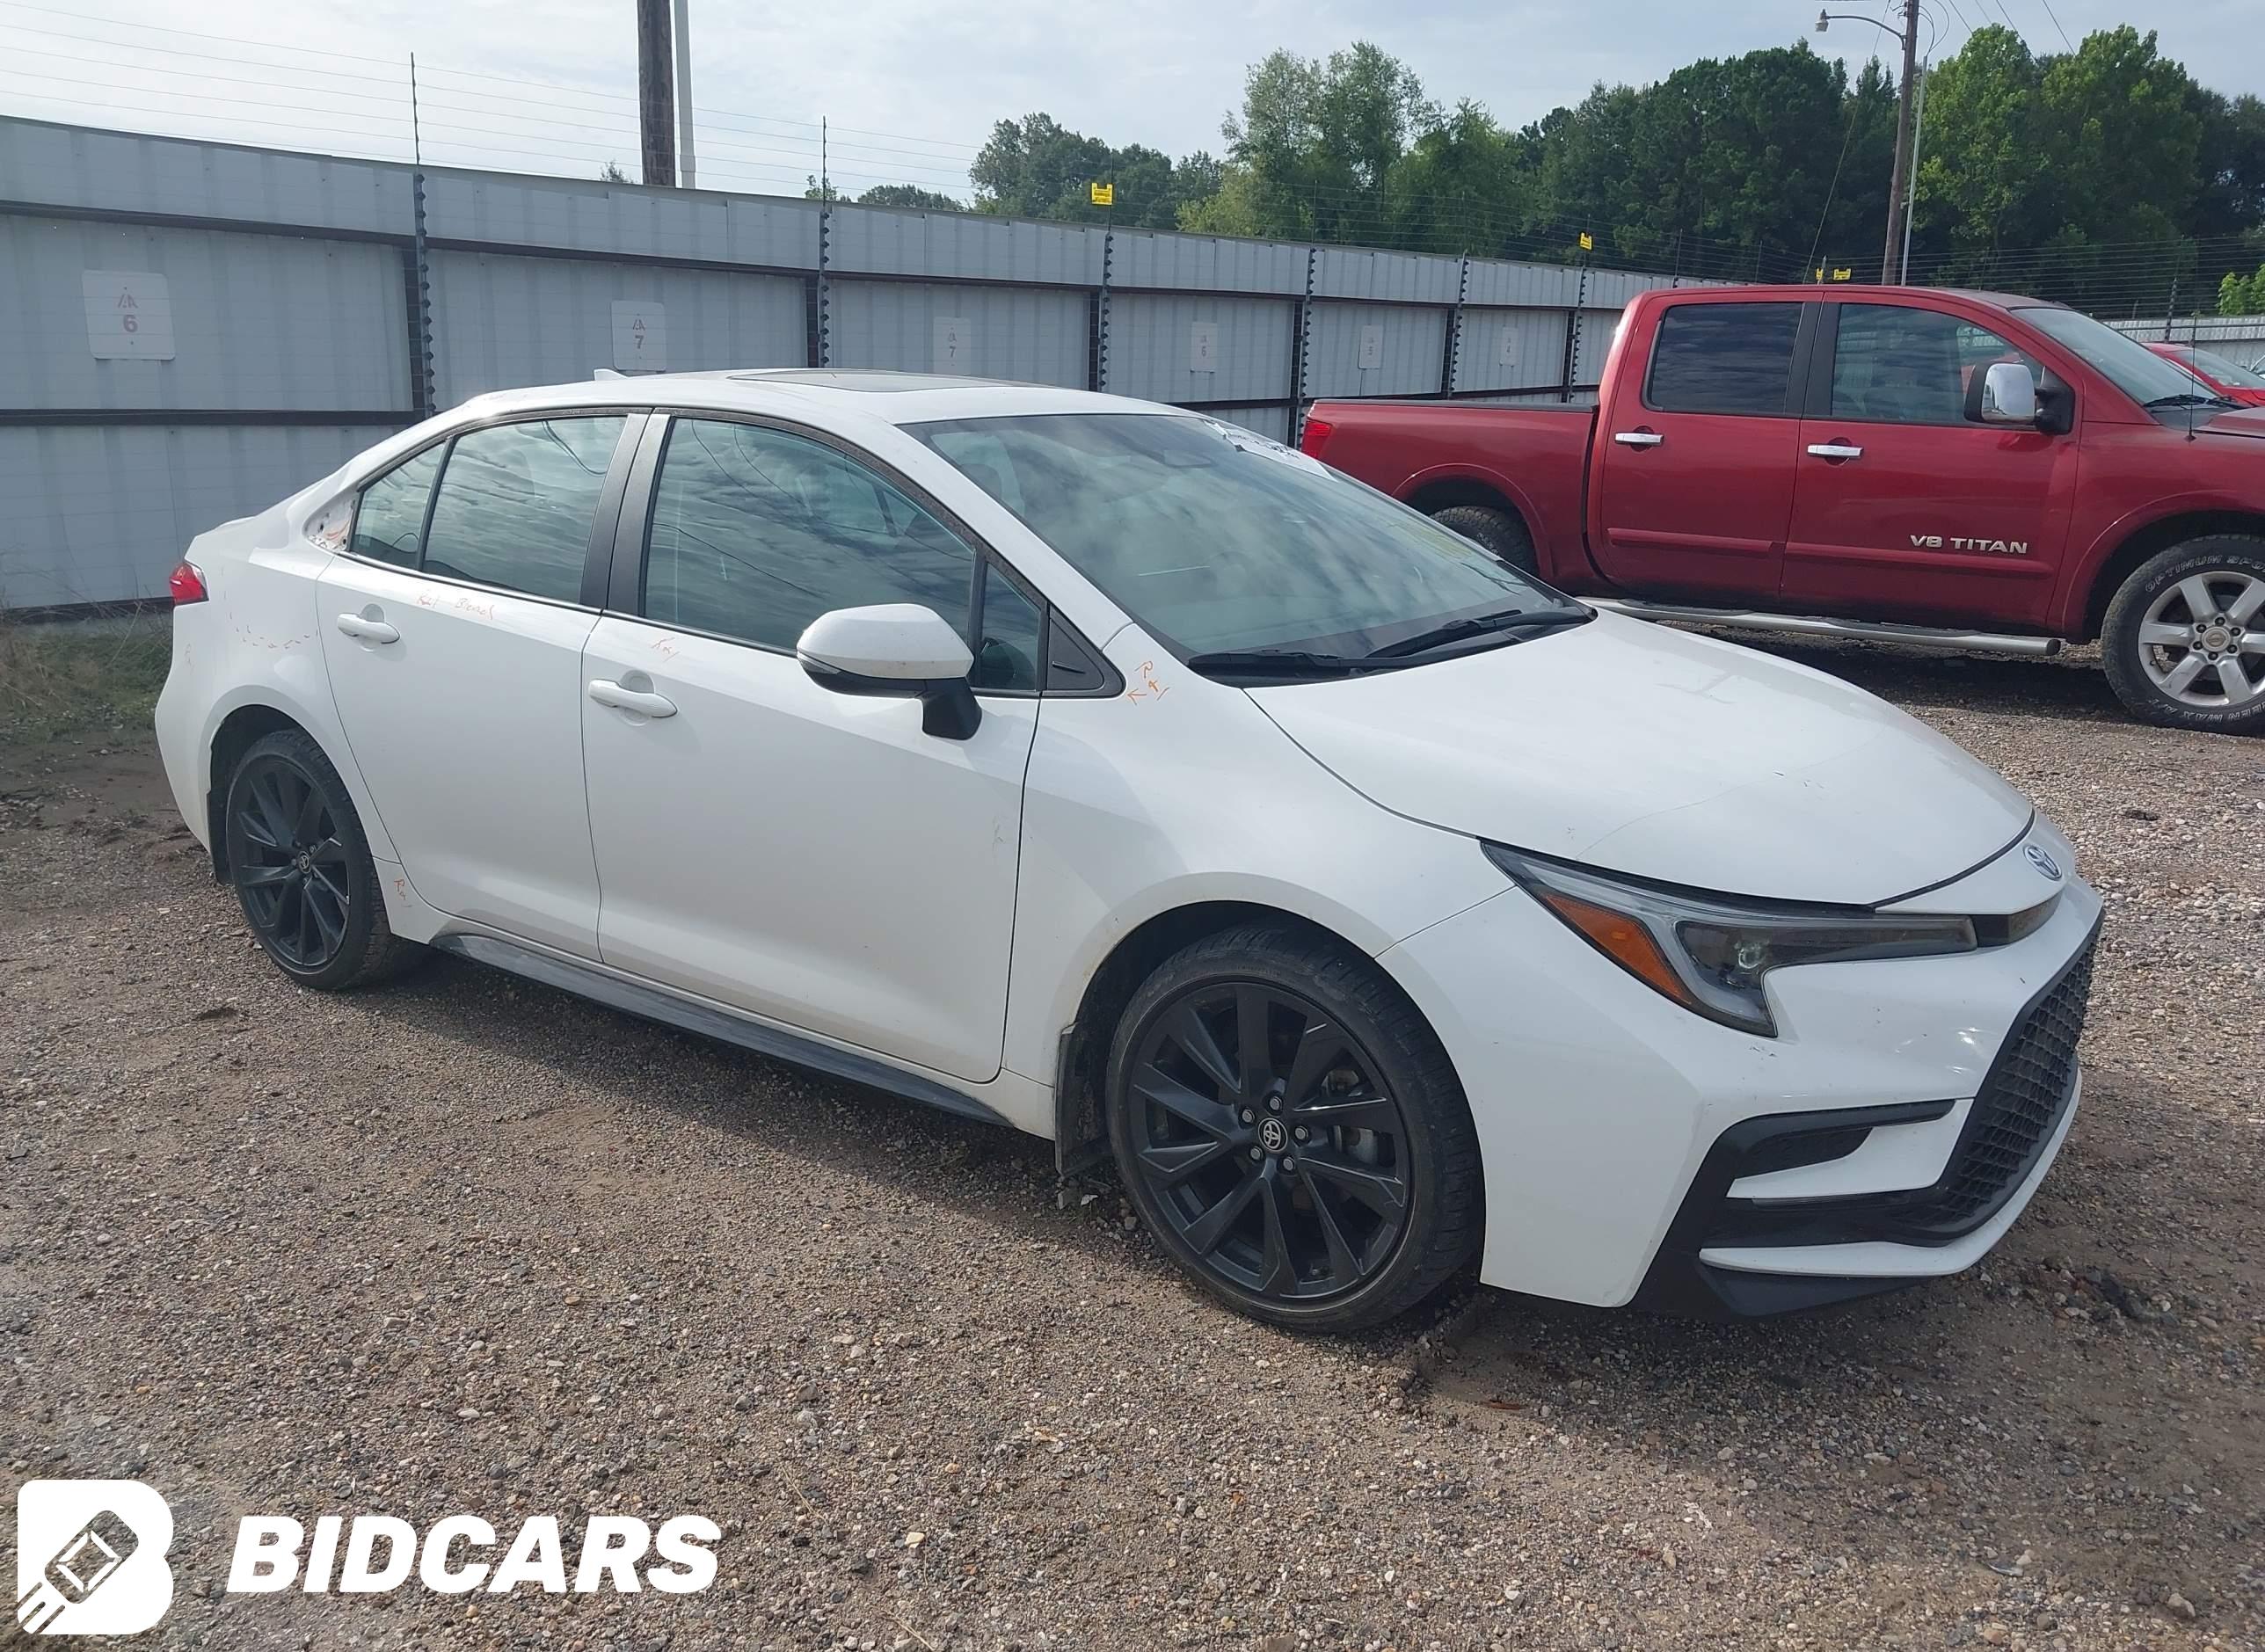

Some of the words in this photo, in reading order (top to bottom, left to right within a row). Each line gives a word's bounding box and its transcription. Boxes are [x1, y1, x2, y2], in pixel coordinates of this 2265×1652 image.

[122, 314, 139, 333] 6
[635, 335, 645, 349] 7
[950, 346, 957, 358] 7
[1910, 535, 1942, 549] V8
[1950, 537, 2028, 554] TITAN
[2145, 555, 2223, 593] OPTIMUM
[2226, 555, 2265, 573] SPO
